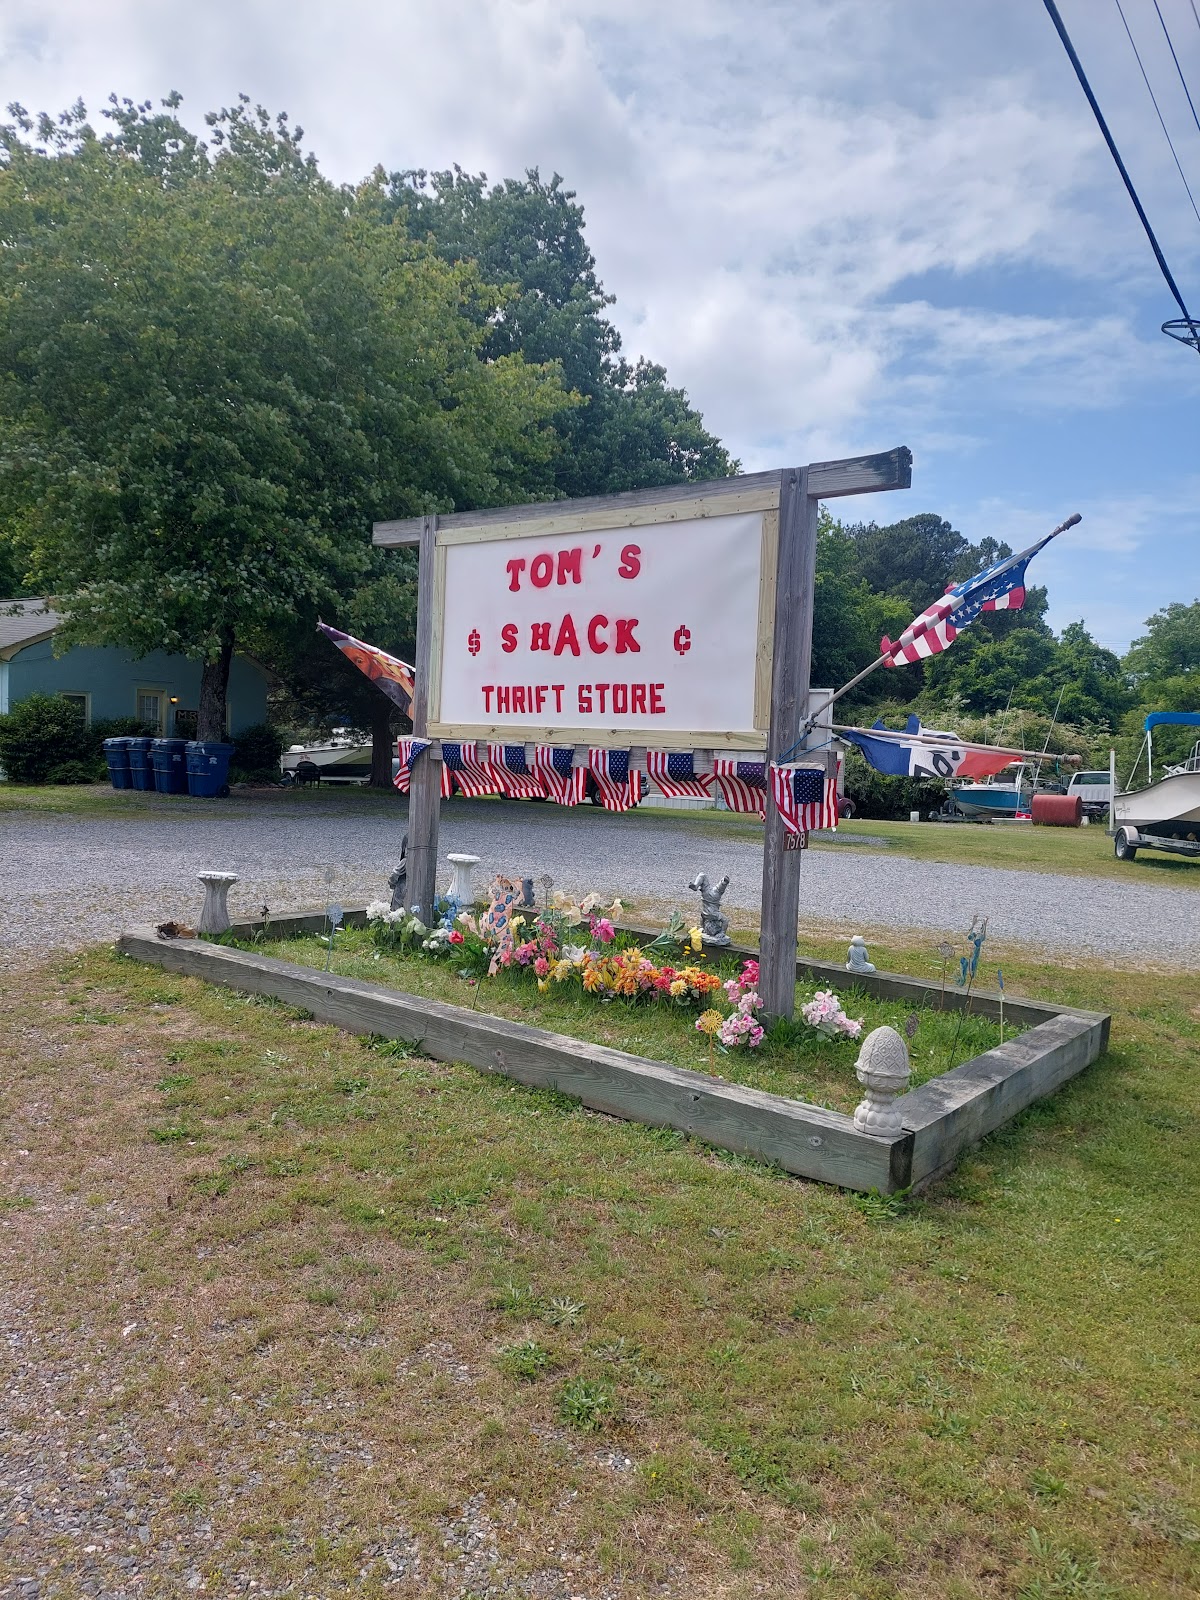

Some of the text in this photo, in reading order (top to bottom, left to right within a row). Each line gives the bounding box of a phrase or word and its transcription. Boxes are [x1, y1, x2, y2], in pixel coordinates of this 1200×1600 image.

[506, 544, 642, 592] TOM'S
[467, 629, 481, 656] $
[501, 613, 641, 656] SHACK
[481, 683, 666, 714] THRIFT STORE
[786, 832, 806, 850] 7578
